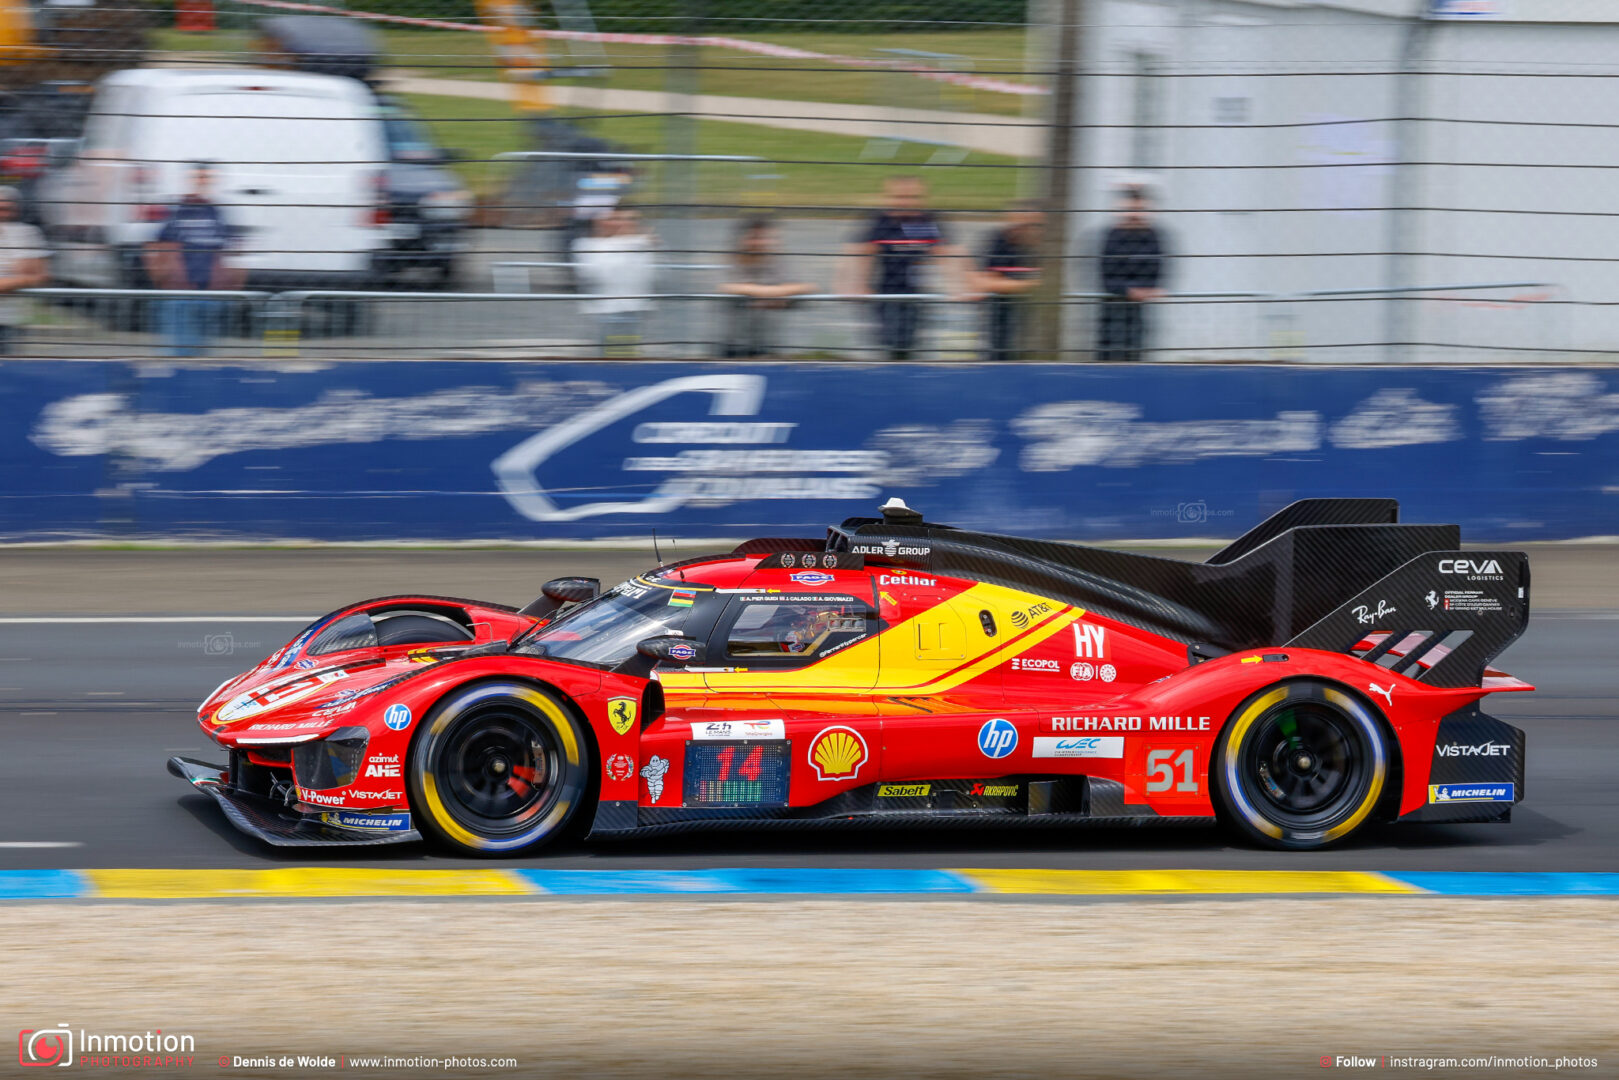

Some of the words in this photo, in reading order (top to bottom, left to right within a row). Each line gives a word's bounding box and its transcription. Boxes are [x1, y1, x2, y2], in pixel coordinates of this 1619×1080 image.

[852, 546, 884, 555] ADLER
[898, 546, 931, 556] GROUP
[879, 574, 937, 587] Cetilar
[1028, 602, 1053, 619] AT&T
[1073, 623, 1105, 659] HY
[1021, 658, 1060, 669] ECOPOL
[388, 704, 408, 730] hp
[1051, 716, 1142, 731] RICHARD
[1149, 716, 1211, 731] MILLE
[983, 719, 1014, 758] hp
[1055, 738, 1101, 749] WEC
[368, 753, 400, 763] azimut
[717, 745, 763, 781] 14
[1146, 749, 1199, 793] 51
[301, 788, 346, 805] V-Power
[883, 786, 925, 797] Sabelt
[1451, 788, 1507, 797] MICHELIN
[343, 816, 403, 827] MICHELIN
